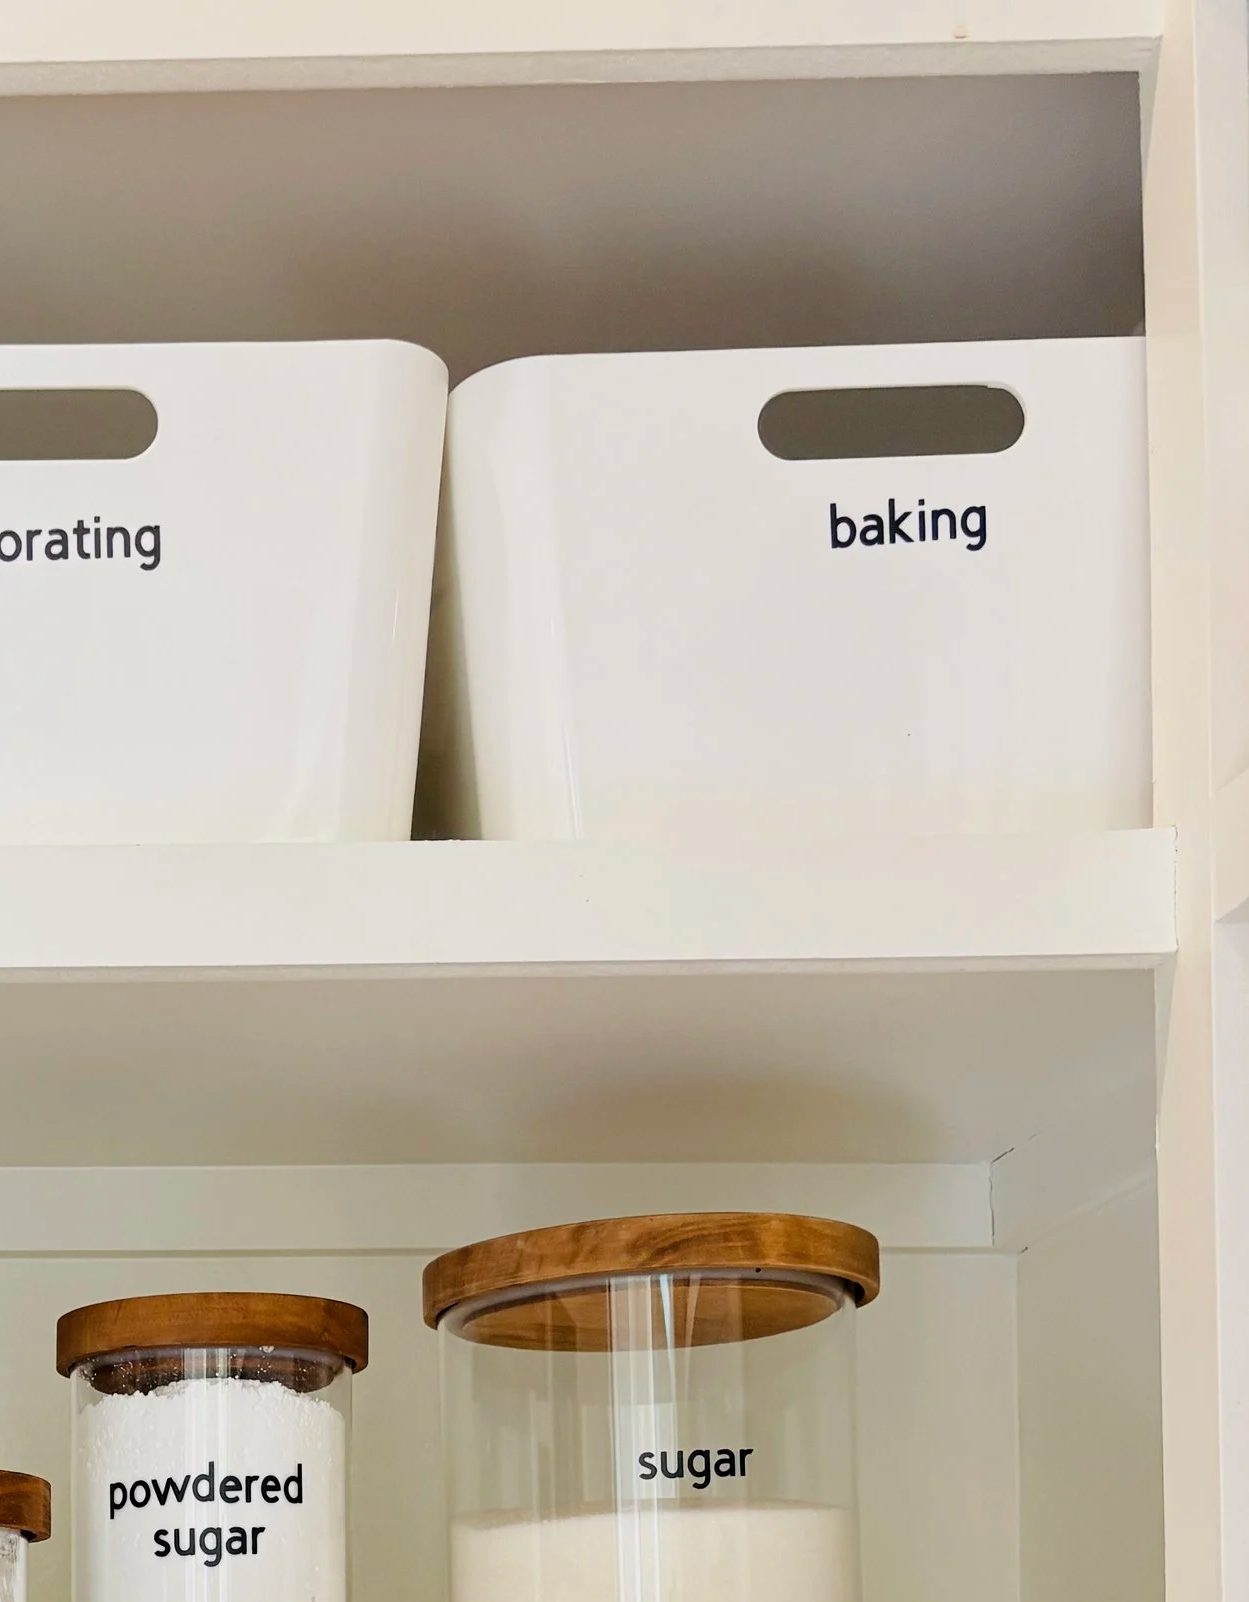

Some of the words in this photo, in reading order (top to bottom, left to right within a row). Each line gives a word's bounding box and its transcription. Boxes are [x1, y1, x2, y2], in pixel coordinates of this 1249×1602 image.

[830, 498, 986, 551] baking
[109, 1461, 304, 1519] powdered
[637, 1444, 754, 1490] sugar
[153, 1519, 266, 1567] sugar
